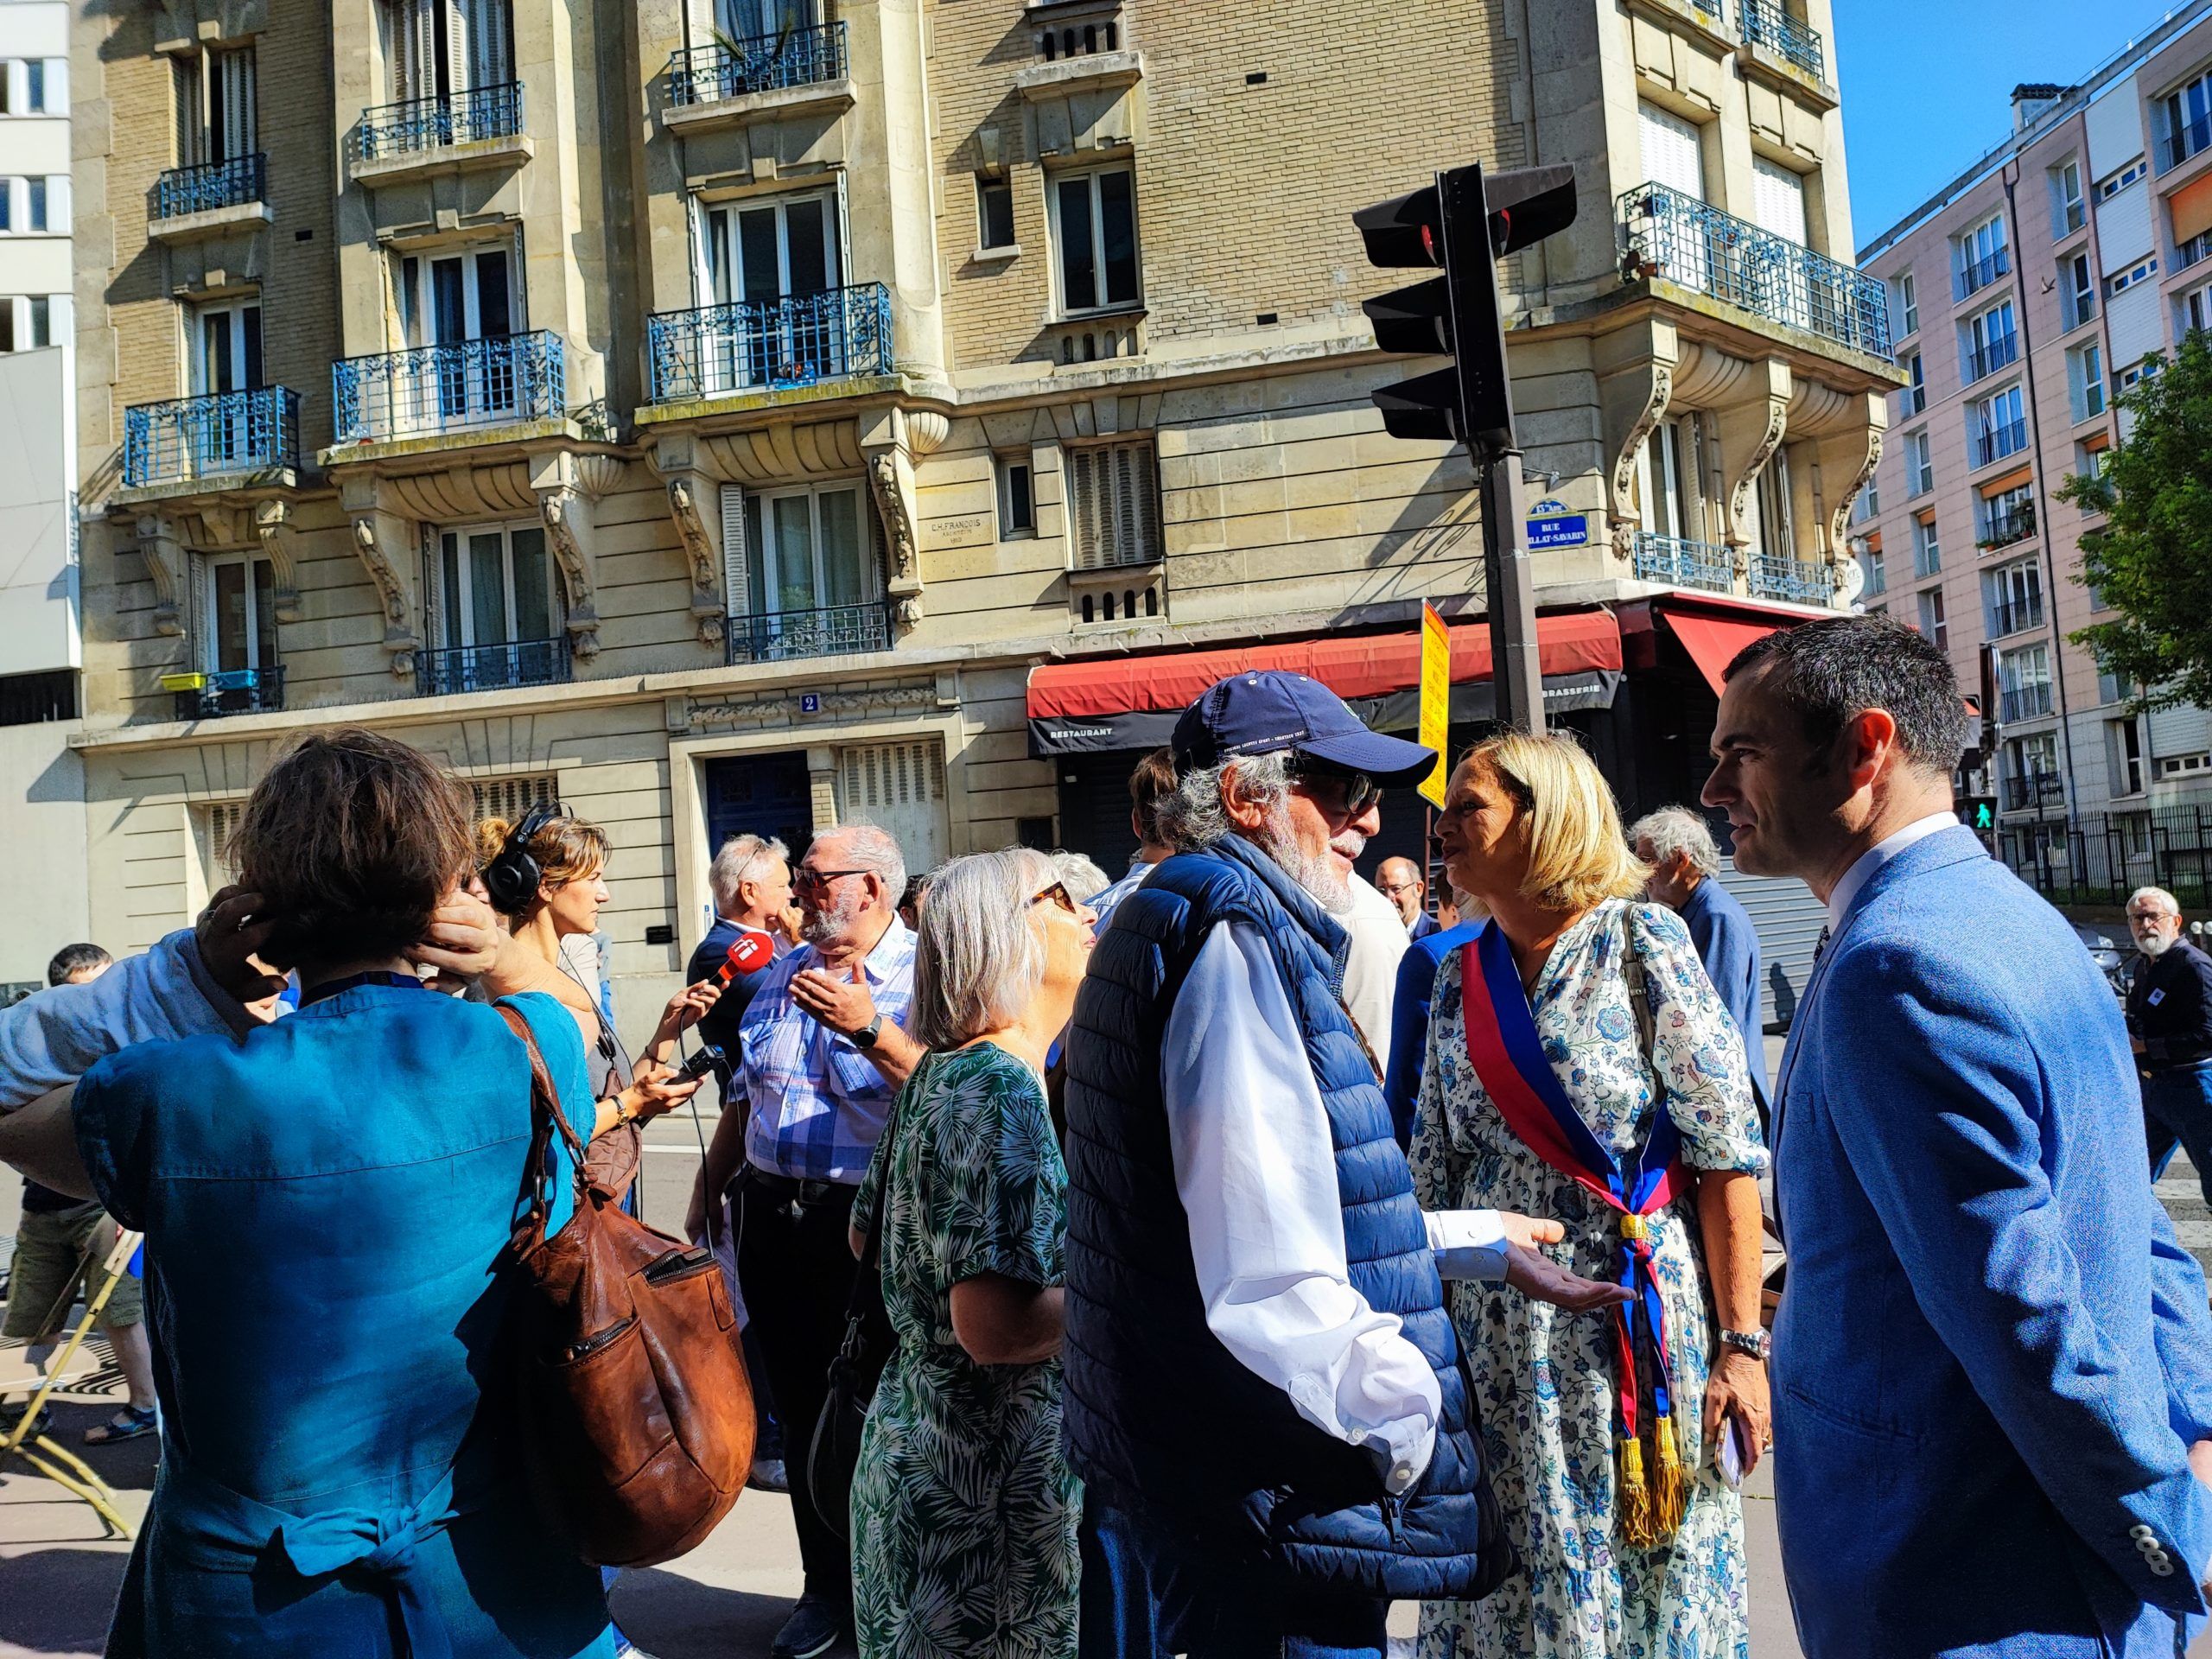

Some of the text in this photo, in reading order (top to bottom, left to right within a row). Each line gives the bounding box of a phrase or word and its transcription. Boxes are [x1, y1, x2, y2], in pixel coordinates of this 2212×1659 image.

[1541, 523, 1560, 531] RUE
[1529, 531, 1586, 544] ILLAT-SAVARIN
[1542, 684, 1600, 698] BRASSERIE
[805, 696, 814, 710] 2
[1050, 728, 1113, 739] RESTAURANT
